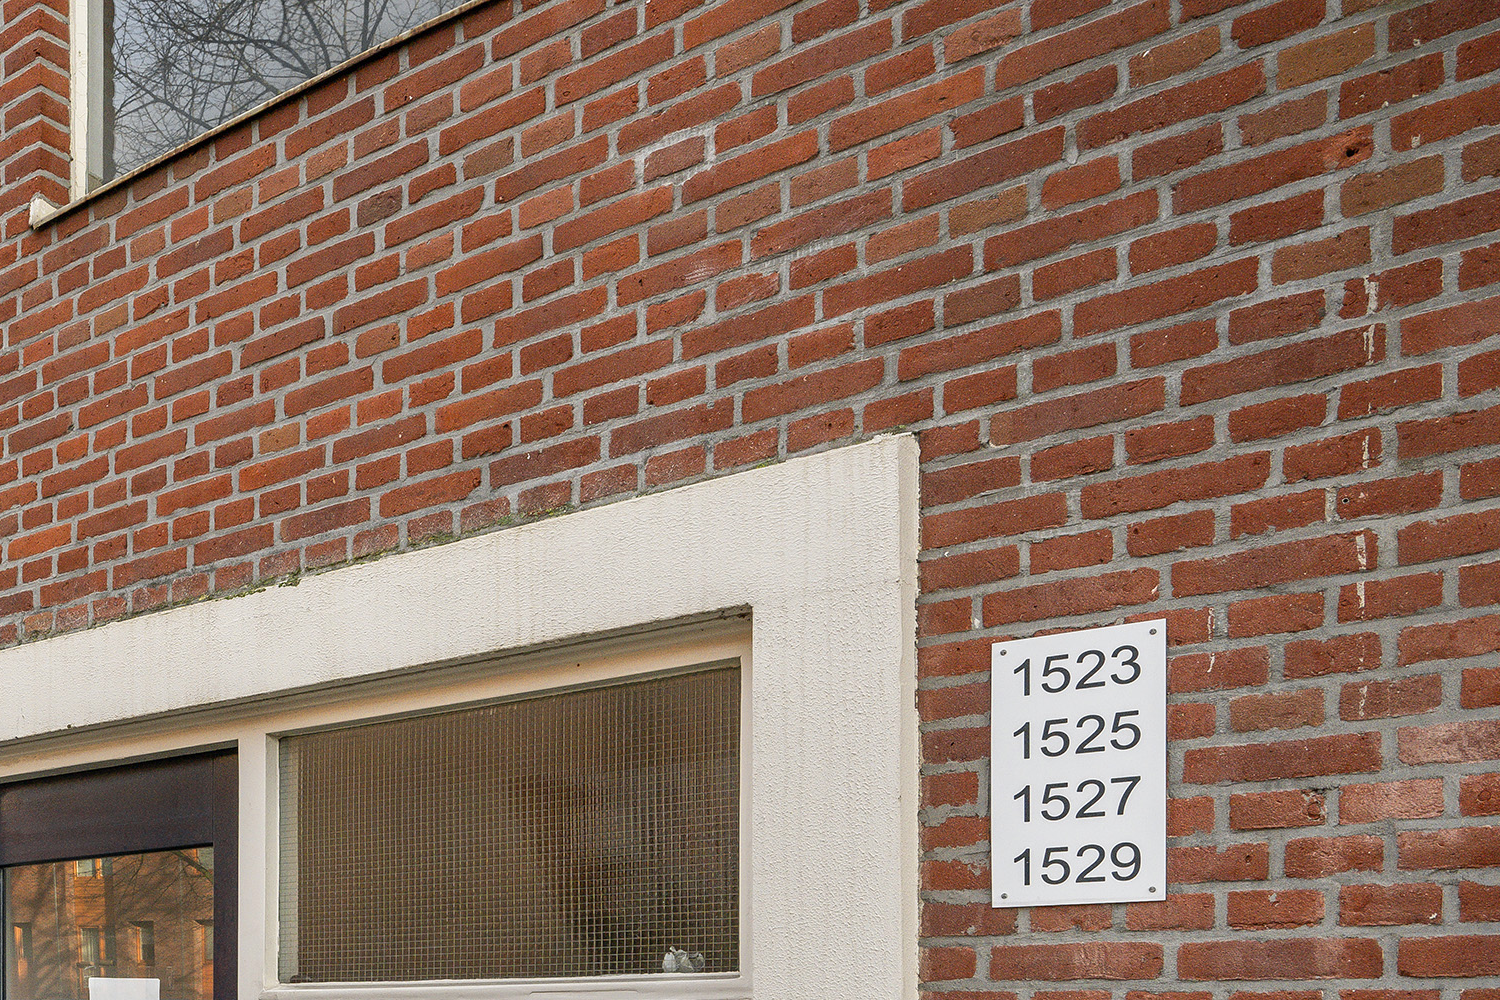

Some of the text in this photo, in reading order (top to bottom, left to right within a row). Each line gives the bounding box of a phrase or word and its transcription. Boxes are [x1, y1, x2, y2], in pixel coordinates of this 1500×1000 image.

[1013, 645, 1141, 696] 1523
[1013, 710, 1141, 759] 1525
[1013, 776, 1141, 822] 1527
[1013, 842, 1141, 885] 1529
